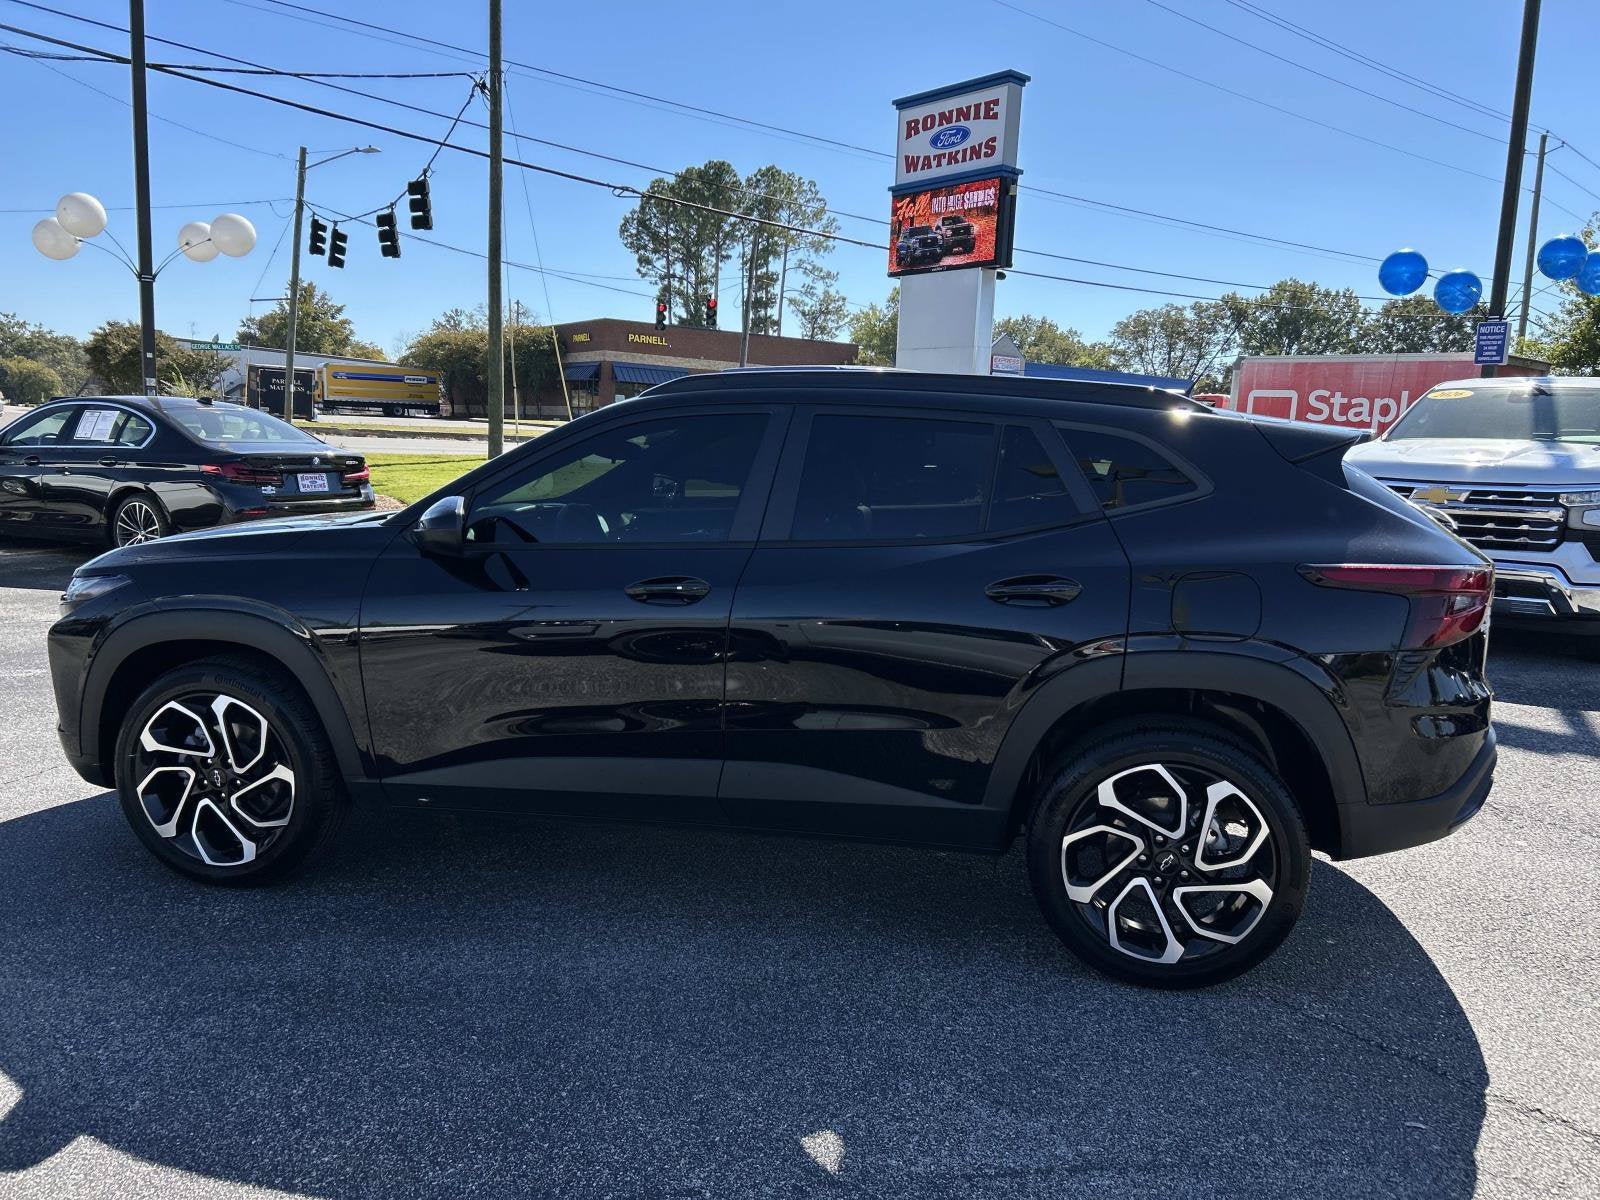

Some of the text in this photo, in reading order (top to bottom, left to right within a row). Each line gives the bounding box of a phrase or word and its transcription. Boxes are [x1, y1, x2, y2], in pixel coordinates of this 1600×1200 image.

[905, 98, 1000, 140] RONNIE
[937, 129, 962, 146] Ford
[904, 136, 997, 174] WATKINS
[897, 193, 931, 220] Fall
[931, 196, 947, 213] INTO
[572, 333, 591, 342] PARNELL
[1480, 325, 1505, 333] NOTICE
[628, 333, 668, 346] PARNELL
